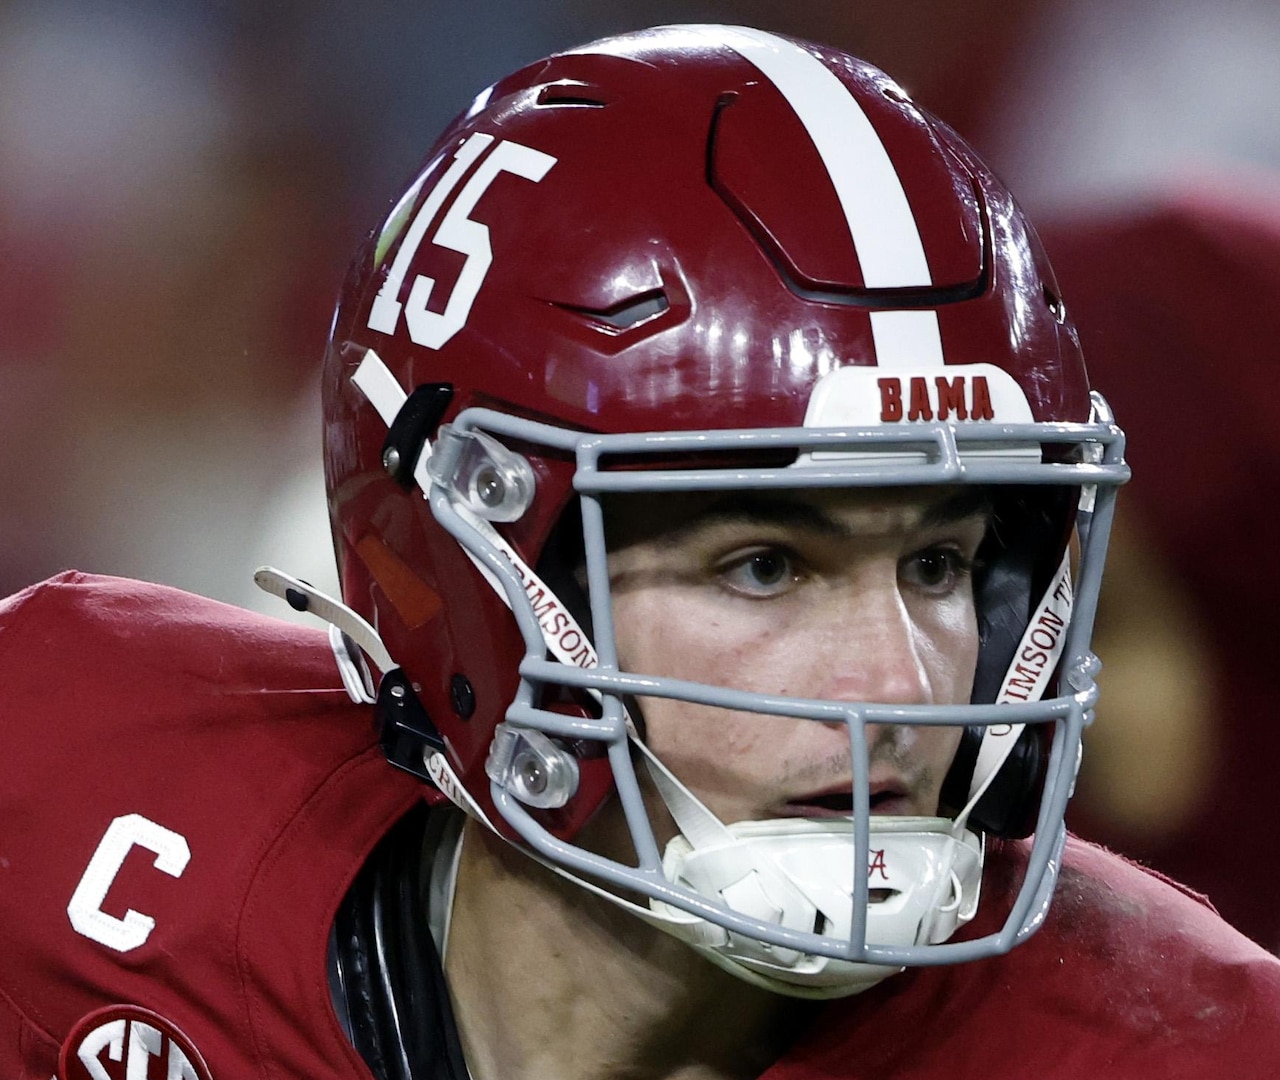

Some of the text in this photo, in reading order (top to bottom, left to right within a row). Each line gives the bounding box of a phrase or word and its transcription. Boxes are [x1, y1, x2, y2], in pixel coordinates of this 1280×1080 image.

[367, 132, 558, 350] 15
[877, 376, 995, 422] BAMA
[67, 813, 191, 952] C
